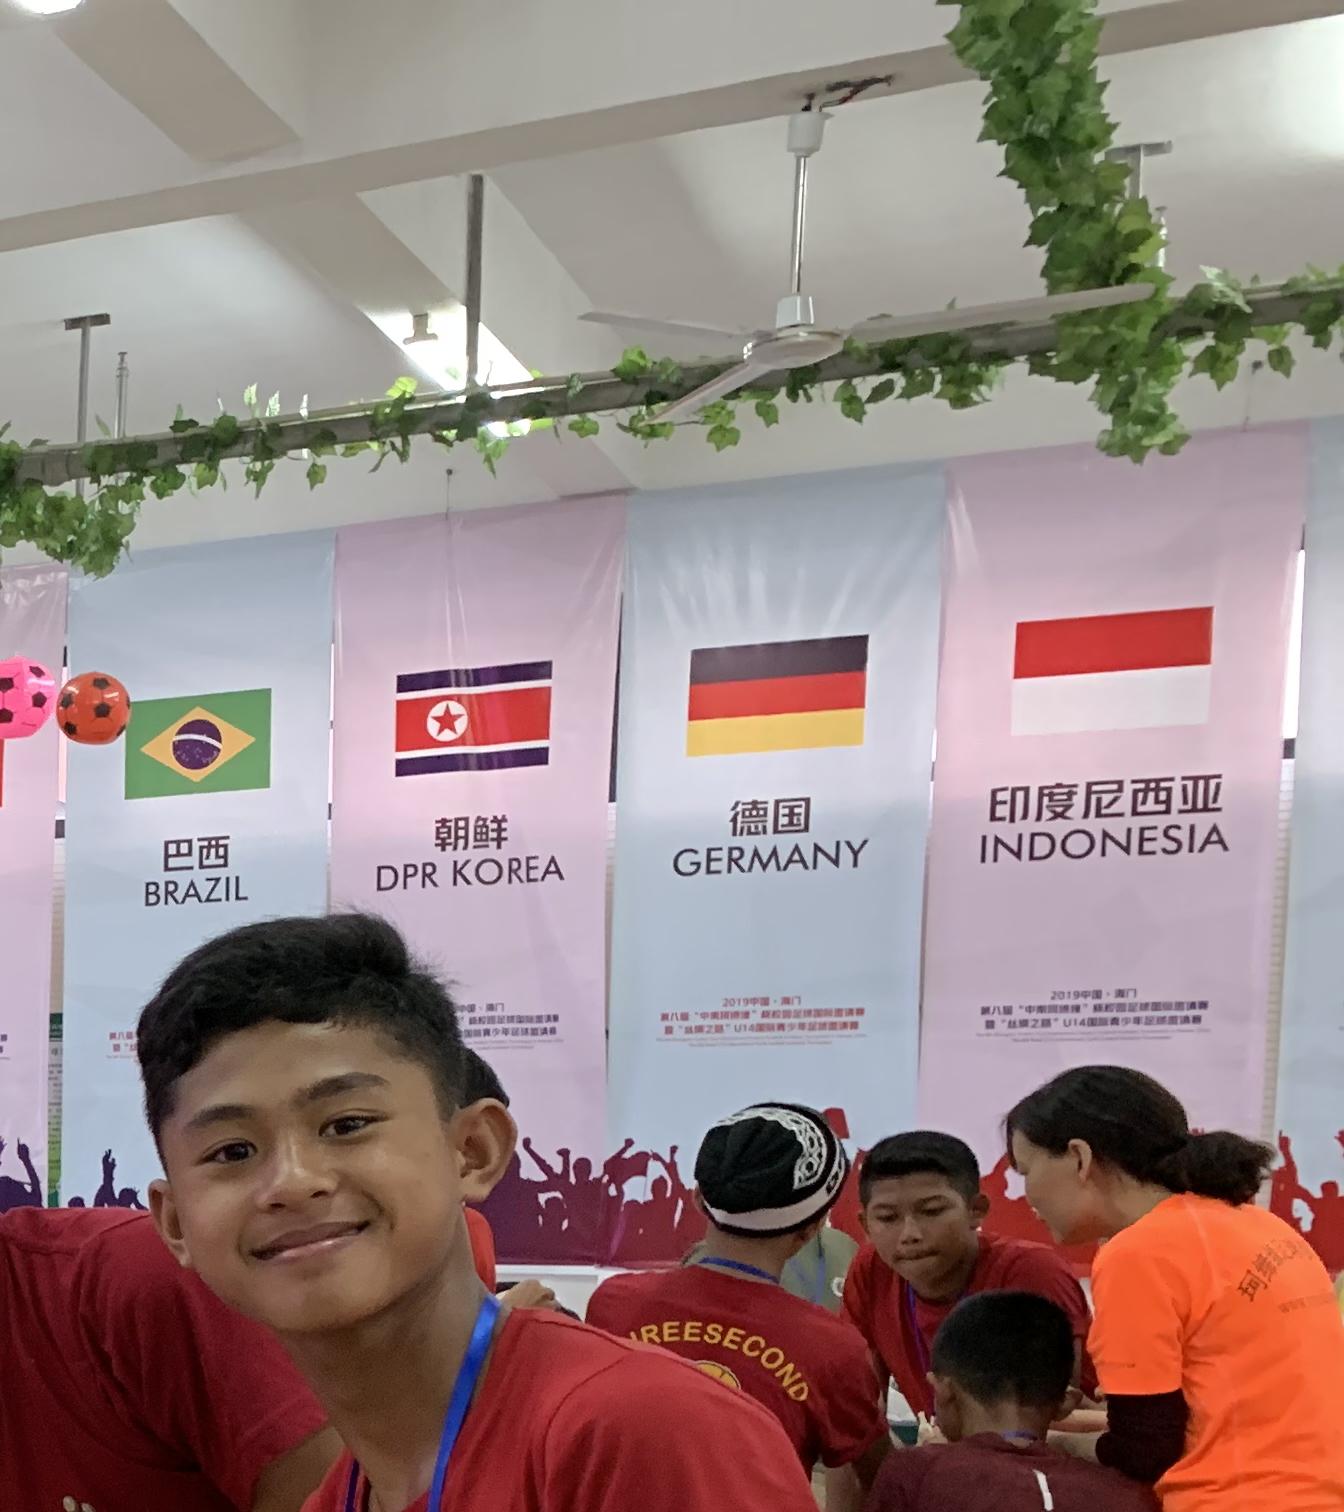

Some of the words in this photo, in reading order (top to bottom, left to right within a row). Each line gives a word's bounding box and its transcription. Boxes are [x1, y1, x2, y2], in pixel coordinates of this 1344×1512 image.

[729, 797, 812, 838] 德国
[989, 773, 1224, 825] 印度尼西亚
[163, 835, 230, 872] 巴西
[434, 815, 510, 853] 朝鲜
[979, 823, 1231, 864] INDONESIA
[376, 861, 439, 893] DPR
[452, 854, 565, 887] KOREA
[672, 838, 870, 878] GERMANY
[143, 875, 249, 908] BRAZIL
